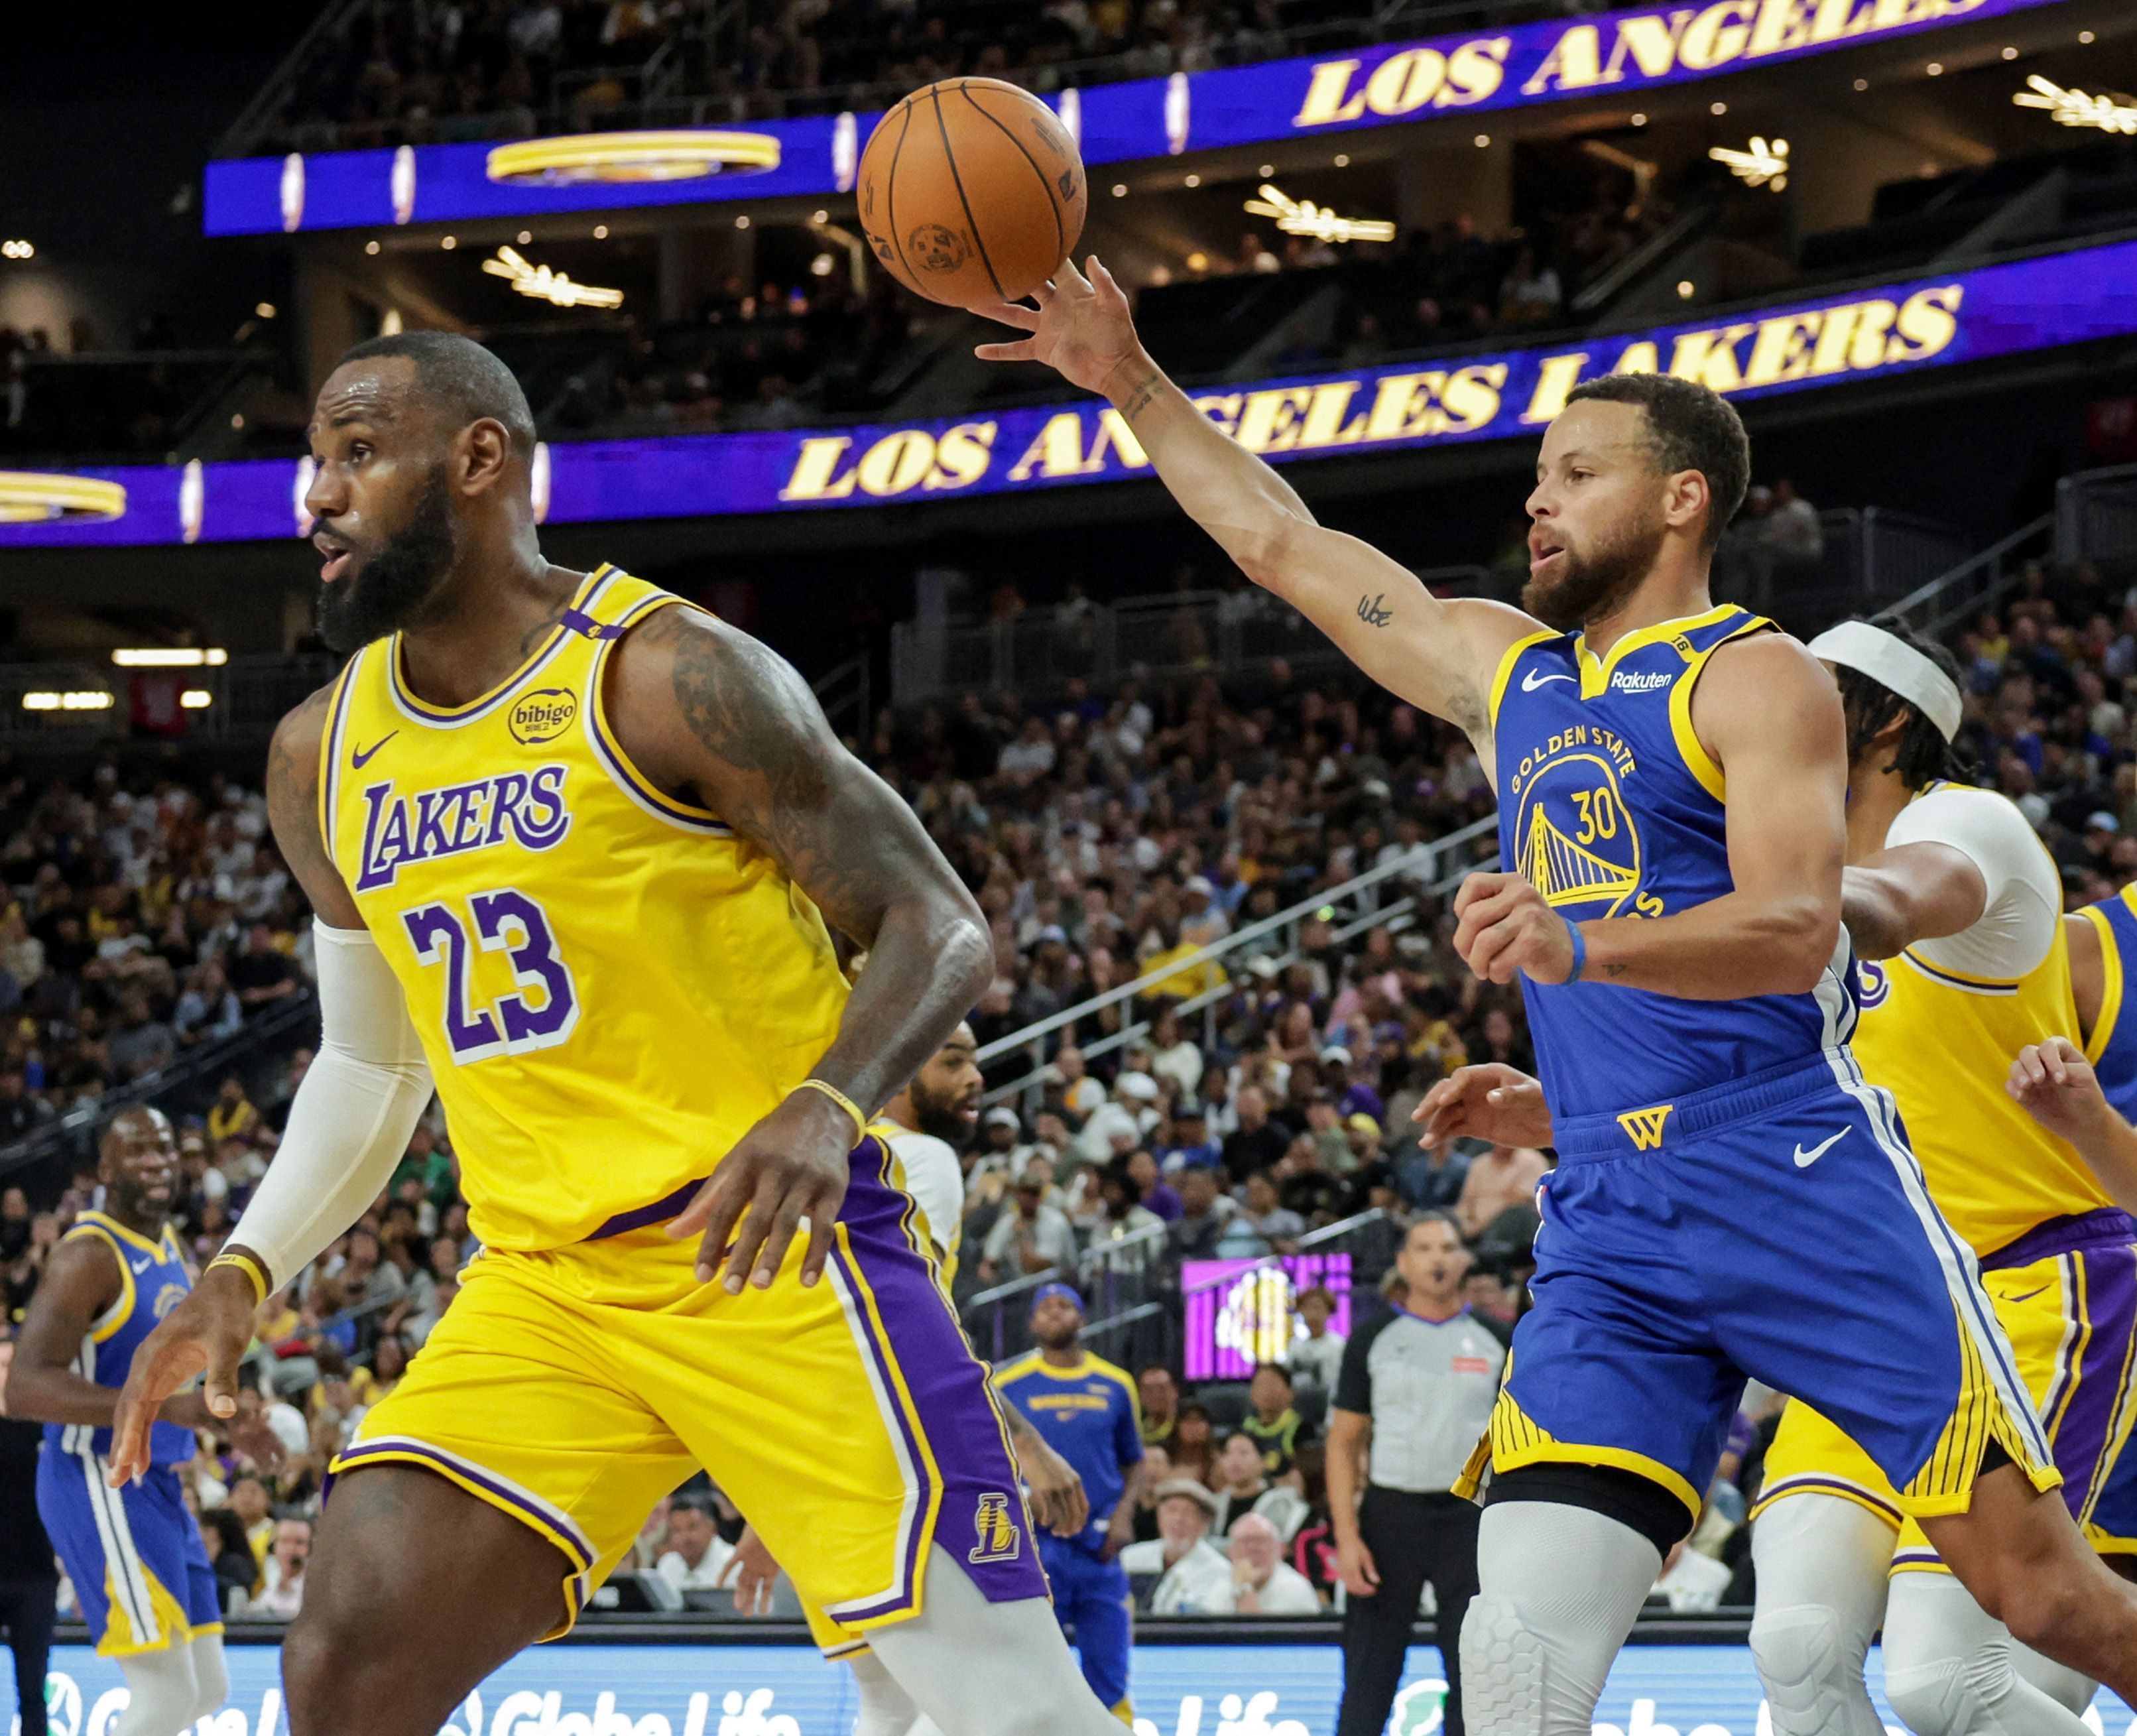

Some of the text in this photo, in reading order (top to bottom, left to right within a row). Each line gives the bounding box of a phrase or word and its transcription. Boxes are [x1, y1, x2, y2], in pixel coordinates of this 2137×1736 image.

[1292, 0, 1988, 127] LOS ANGEL
[778, 421, 998, 501] LOS
[516, 703, 574, 725] bibigo
[1611, 671, 1672, 689] Rakuten
[1511, 724, 1637, 794] GOLDEN STATE
[356, 763, 573, 895] LAKERS
[1570, 786, 1617, 845] 30
[398, 887, 581, 1067] 23
